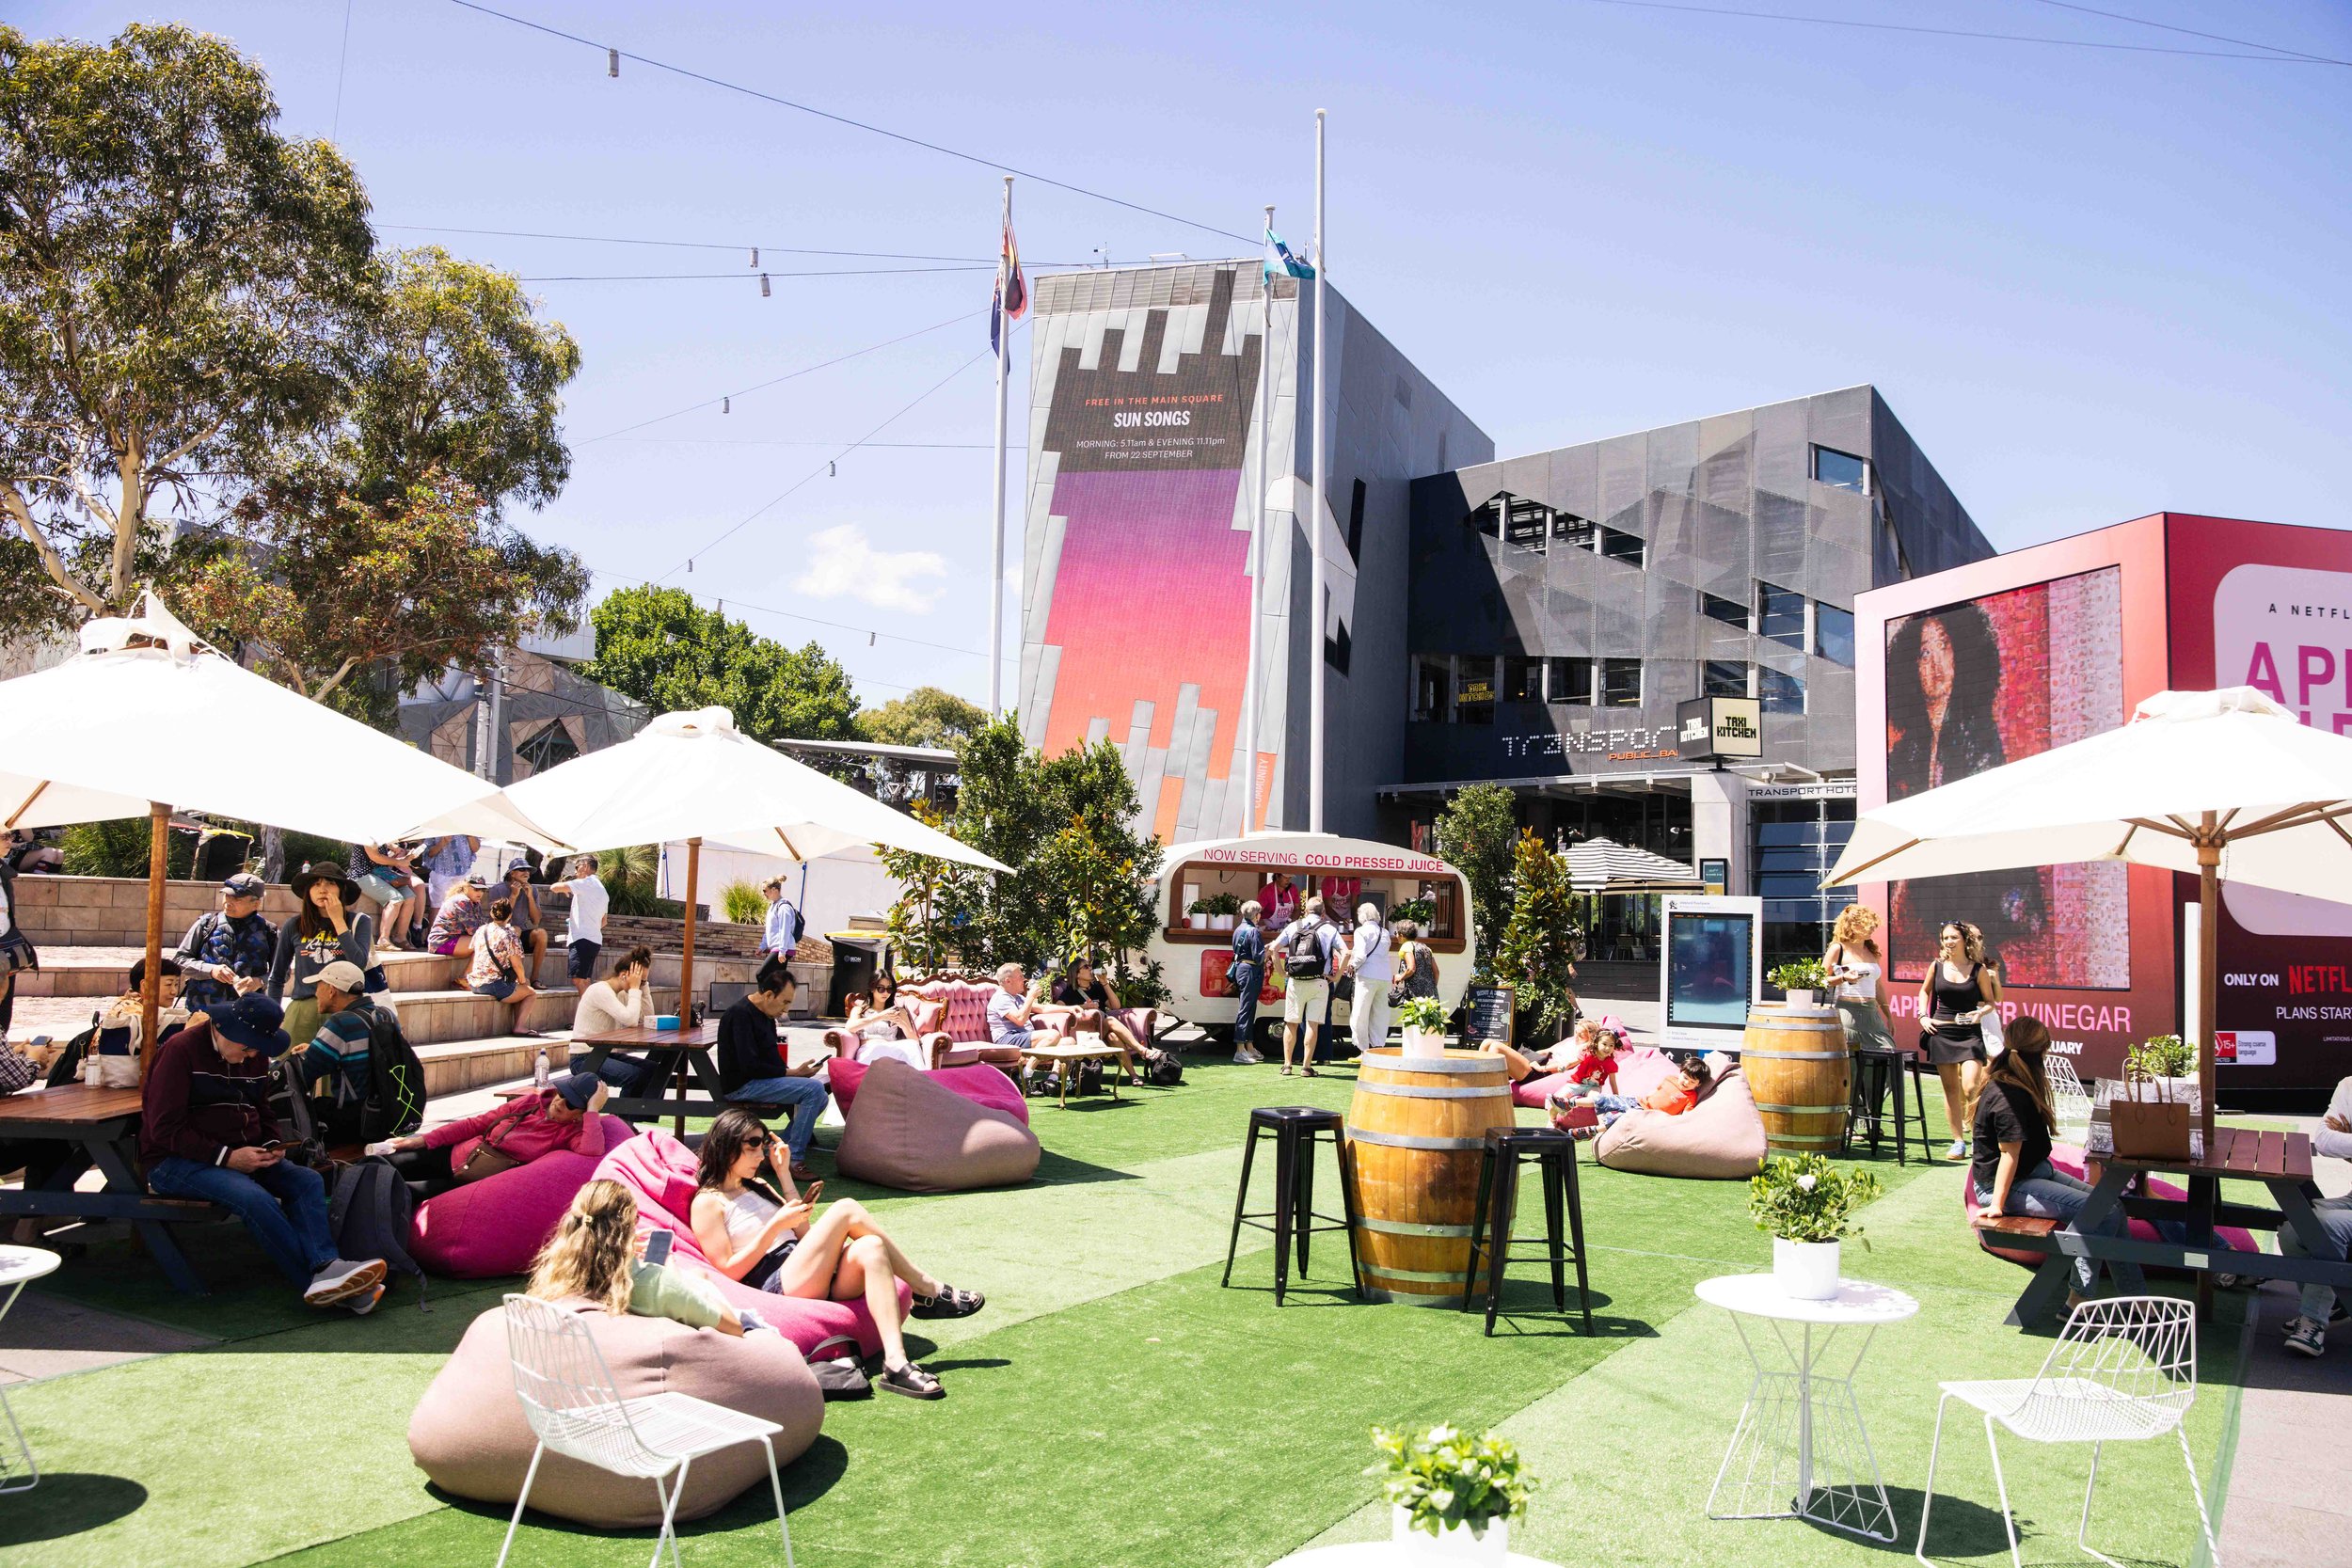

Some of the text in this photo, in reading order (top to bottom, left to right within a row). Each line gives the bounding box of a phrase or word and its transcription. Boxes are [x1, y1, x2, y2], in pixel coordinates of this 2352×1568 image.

[1085, 398, 1110, 406] FREE
[1129, 397, 1148, 405] THE
[1152, 396, 1178, 404] MAIN
[1181, 394, 1223, 404] SQUARE
[1113, 410, 1191, 428] SUN SONGS
[1076, 439, 1119, 449] MORNING:
[1120, 438, 1146, 448] 5.11am
[1148, 438, 1154, 447] &
[1156, 437, 1195, 447] EVENING
[1104, 451, 1129, 460] FROM
[1142, 451, 1193, 459] SEPTEMBER
[2268, 603, 2350, 620] A NETFL
[2245, 641, 2352, 708] AP
[1686, 717, 1702, 731] TAXI
[1725, 716, 1747, 727] TAXI
[1717, 726, 1756, 738] KITCHEN
[1608, 750, 1678, 761] PUBLIC_BA
[1748, 785, 1857, 797] TRANSPORT HOTE
[1203, 848, 1443, 871] NOW SERVING COLD PRESSED JUICE
[2224, 965, 2352, 994] ONLY ON NETFL
[1889, 995, 1931, 1018] APP
[2024, 1002, 2132, 1033] VINEGAR
[2276, 1006, 2352, 1020] PLANS STAR
[2223, 1040, 2235, 1049] 15+
